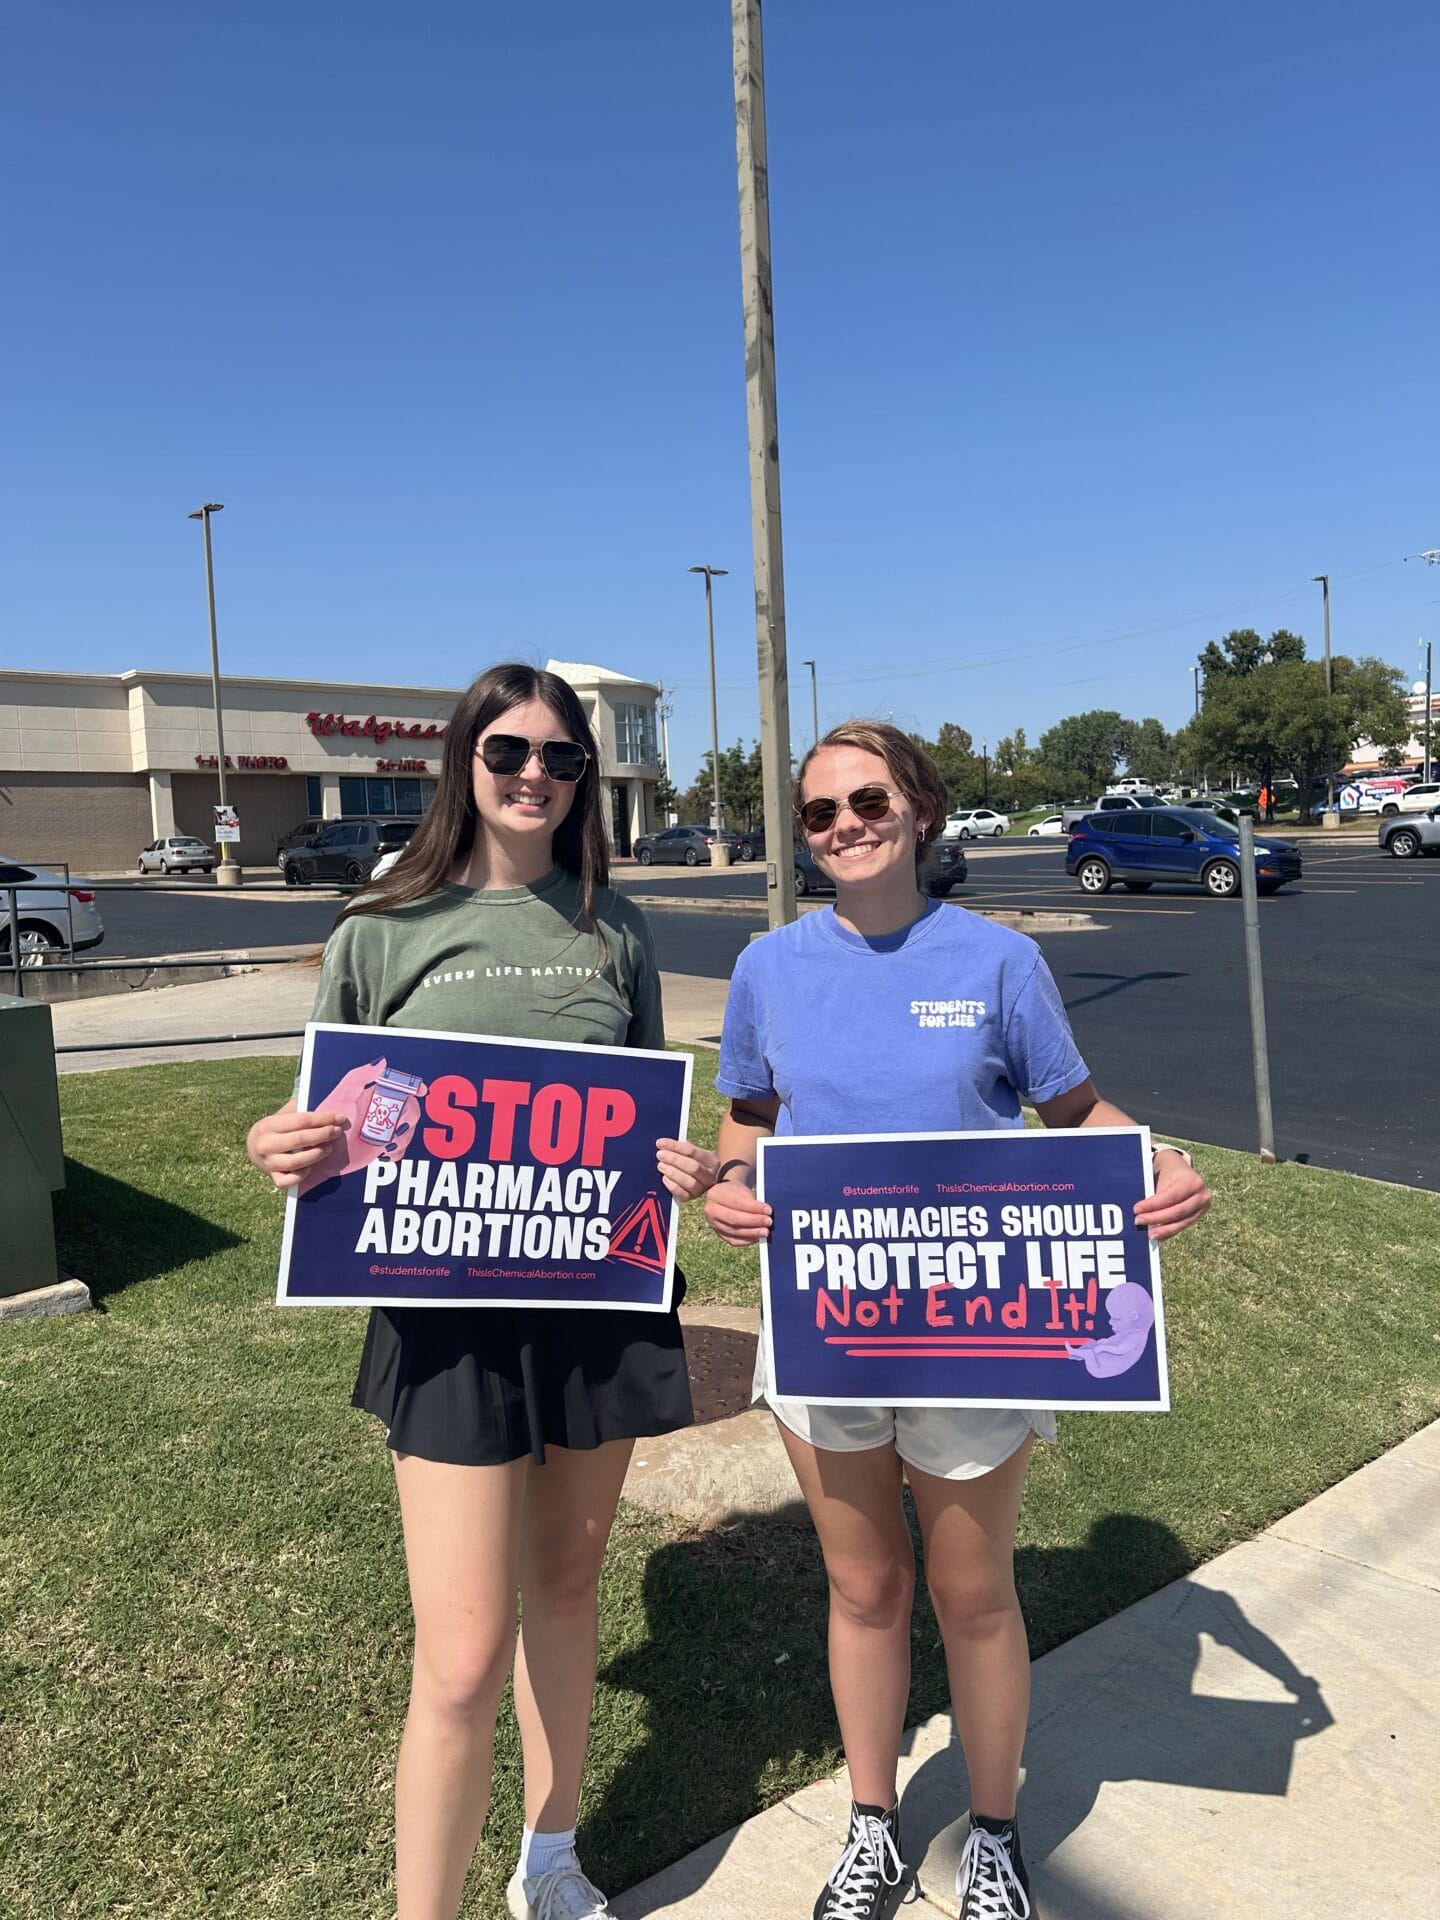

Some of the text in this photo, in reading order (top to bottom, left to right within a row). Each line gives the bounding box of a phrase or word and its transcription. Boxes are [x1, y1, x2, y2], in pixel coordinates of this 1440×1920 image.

[306, 712, 448, 744] Walgree
[237, 755, 288, 770] PHOTO
[376, 759, 427, 773] 24-HRS
[423, 970, 475, 988] EVERY
[486, 966, 523, 977] LIFE
[910, 1000, 986, 1015] STUDENTS
[919, 1013, 976, 1028] FOR LIFE
[422, 1074, 636, 1167] STOP
[363, 1158, 622, 1214] PHARMACY
[842, 1182, 1075, 1197] @studentsforlife ThisIsChemicalAbortion.com
[354, 1207, 612, 1261] ABORTIONS
[791, 1203, 1124, 1240] PHARMACIES SHOULD
[368, 1264, 596, 1280] @studentsforlife ThisIsChemicalAbortion.com
[795, 1240, 1127, 1291] PROTECT LIFE
[815, 1278, 1098, 1331] Not End It!
